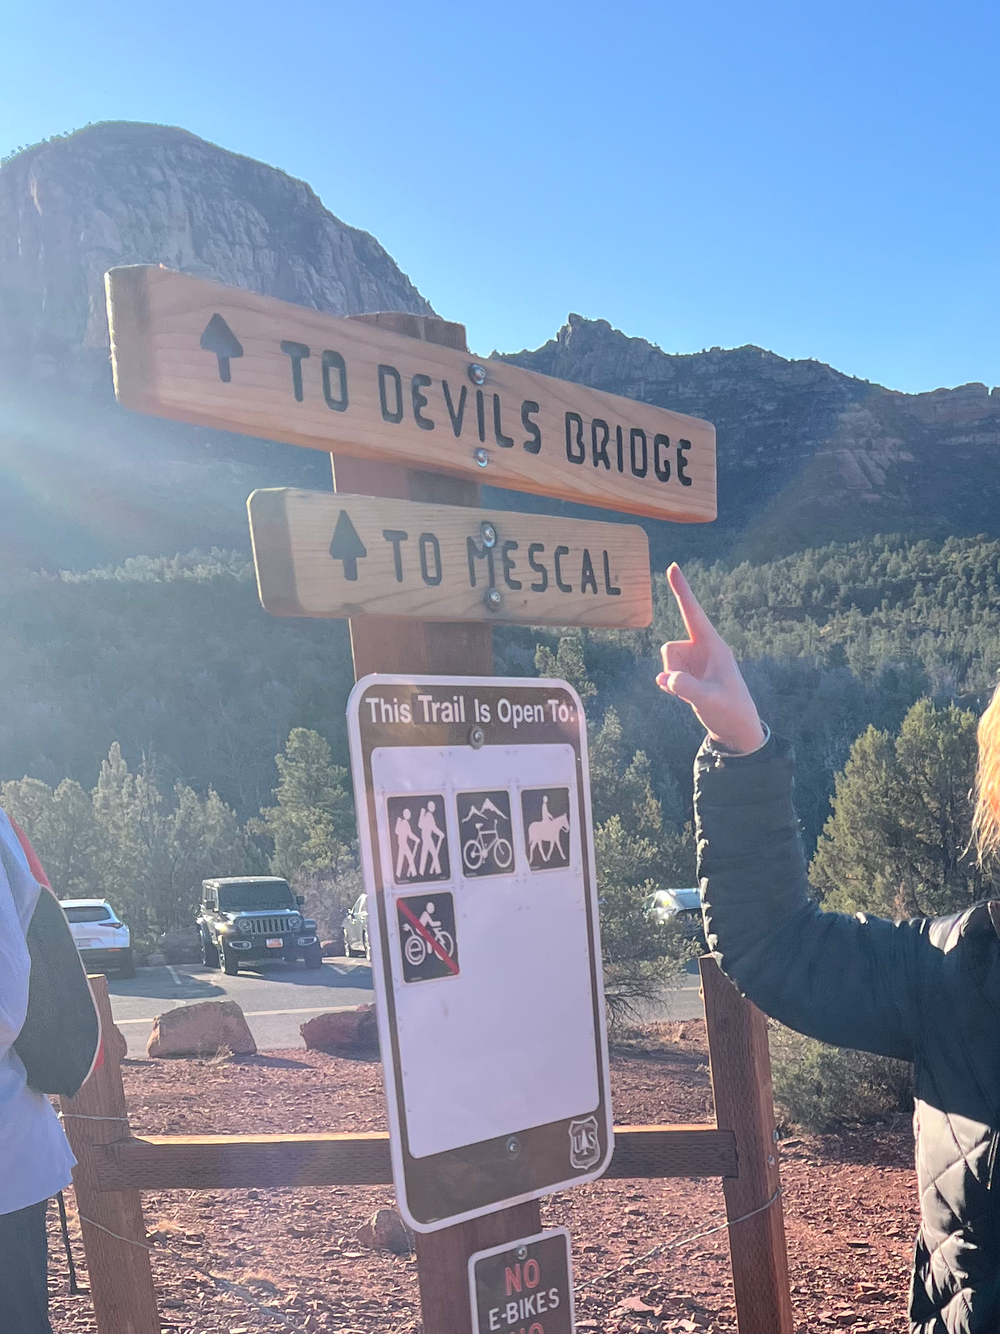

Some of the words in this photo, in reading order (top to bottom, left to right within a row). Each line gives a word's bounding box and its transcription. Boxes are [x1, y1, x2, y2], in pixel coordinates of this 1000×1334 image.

[280, 339, 349, 412] TO
[378, 365, 542, 455] DEVILS
[564, 411, 693, 487] BRIDGE
[382, 529, 442, 587] TO
[467, 536, 622, 597] MESCAL
[365, 697, 412, 724] This
[417, 694, 466, 723] Trail
[474, 698, 491, 723] Is
[497, 698, 545, 730] Open
[547, 699, 575, 723] To:
[505, 1258, 540, 1296] NO
[489, 1287, 560, 1331] E-BIKES
